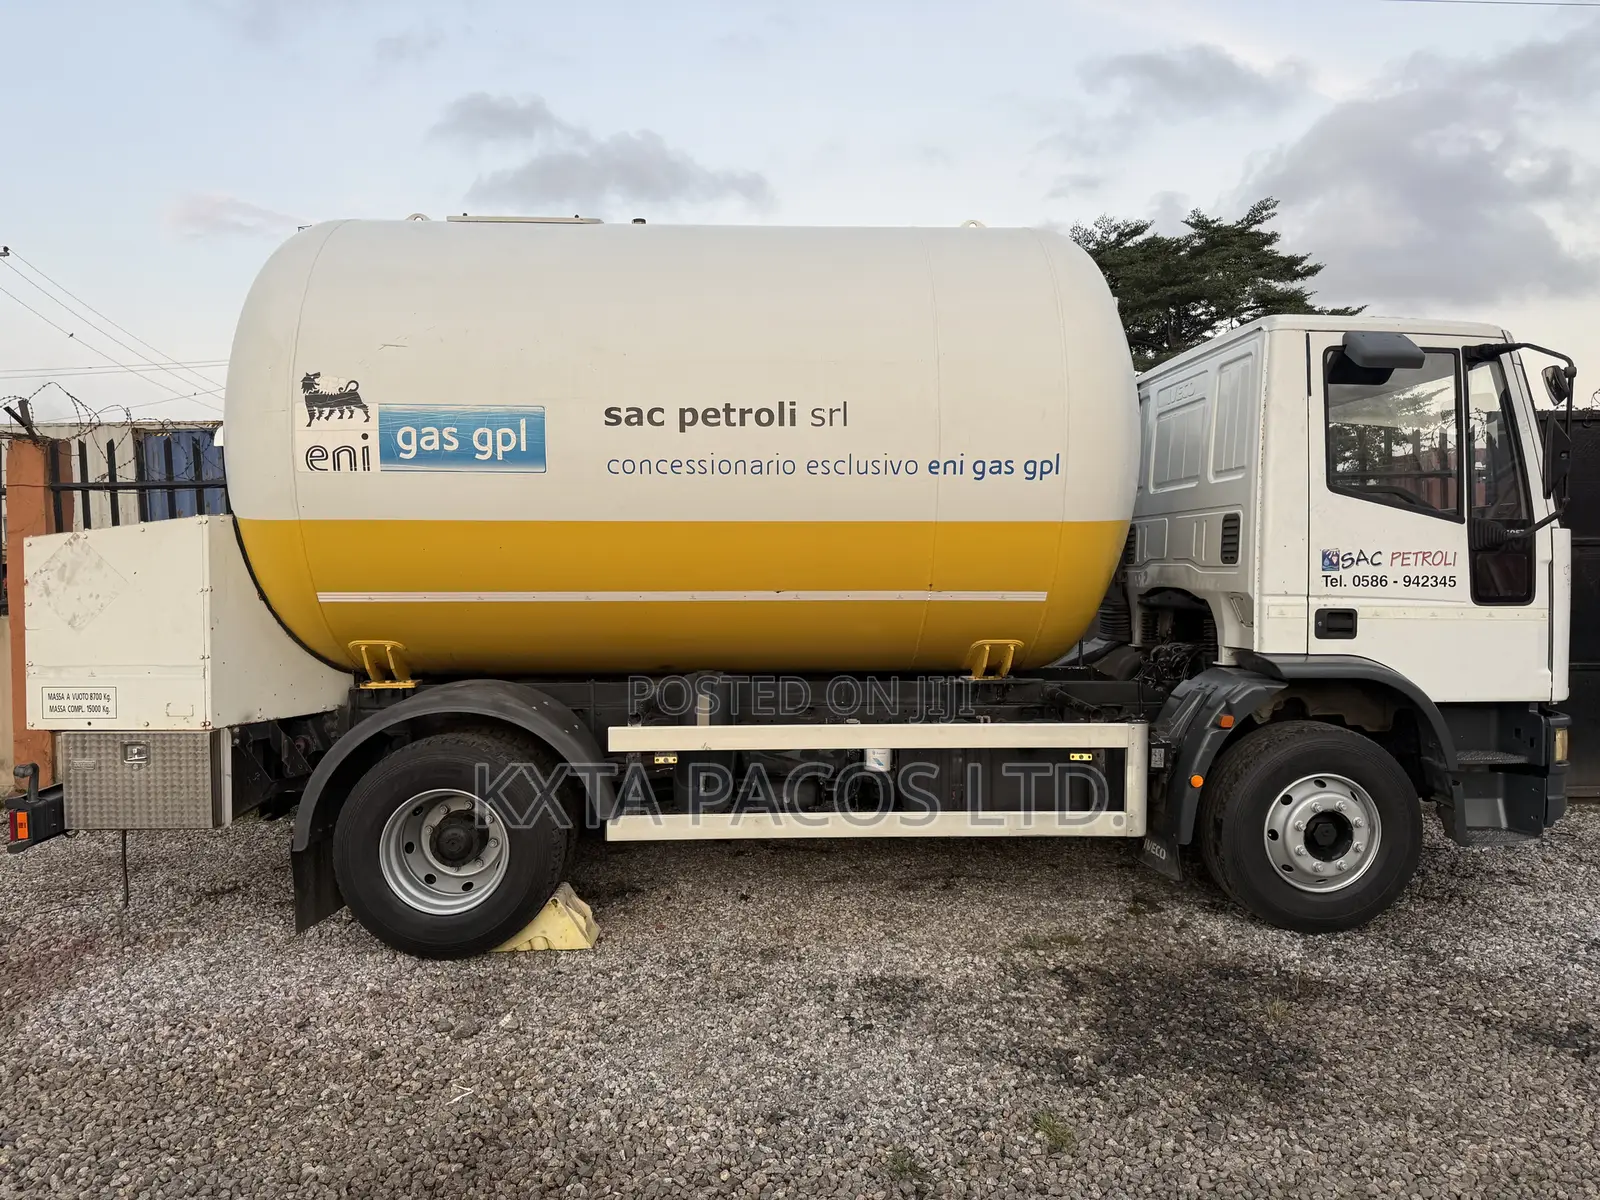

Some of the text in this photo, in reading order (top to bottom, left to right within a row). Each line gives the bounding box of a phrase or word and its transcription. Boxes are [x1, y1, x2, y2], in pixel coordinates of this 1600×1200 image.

[603, 400, 848, 433] sac petroli srl
[396, 418, 527, 461] gas gpl
[305, 432, 371, 472] eni
[606, 452, 1061, 482] concessionario esclusivo eni gas gpl
[1340, 549, 1457, 570] SAC PETROLI
[1321, 575, 1347, 588] Tel.
[1352, 575, 1389, 588] 0586
[1402, 575, 1457, 588] 942345
[47, 692, 65, 700] MASSA
[66, 692, 71, 700] A
[72, 692, 89, 700] VUOTO
[89, 692, 103, 700] 8700
[49, 705, 66, 713] MASSA
[67, 705, 85, 713] COMPL.
[86, 704, 102, 713] 15000
[1143, 838, 1167, 860] IVECO
